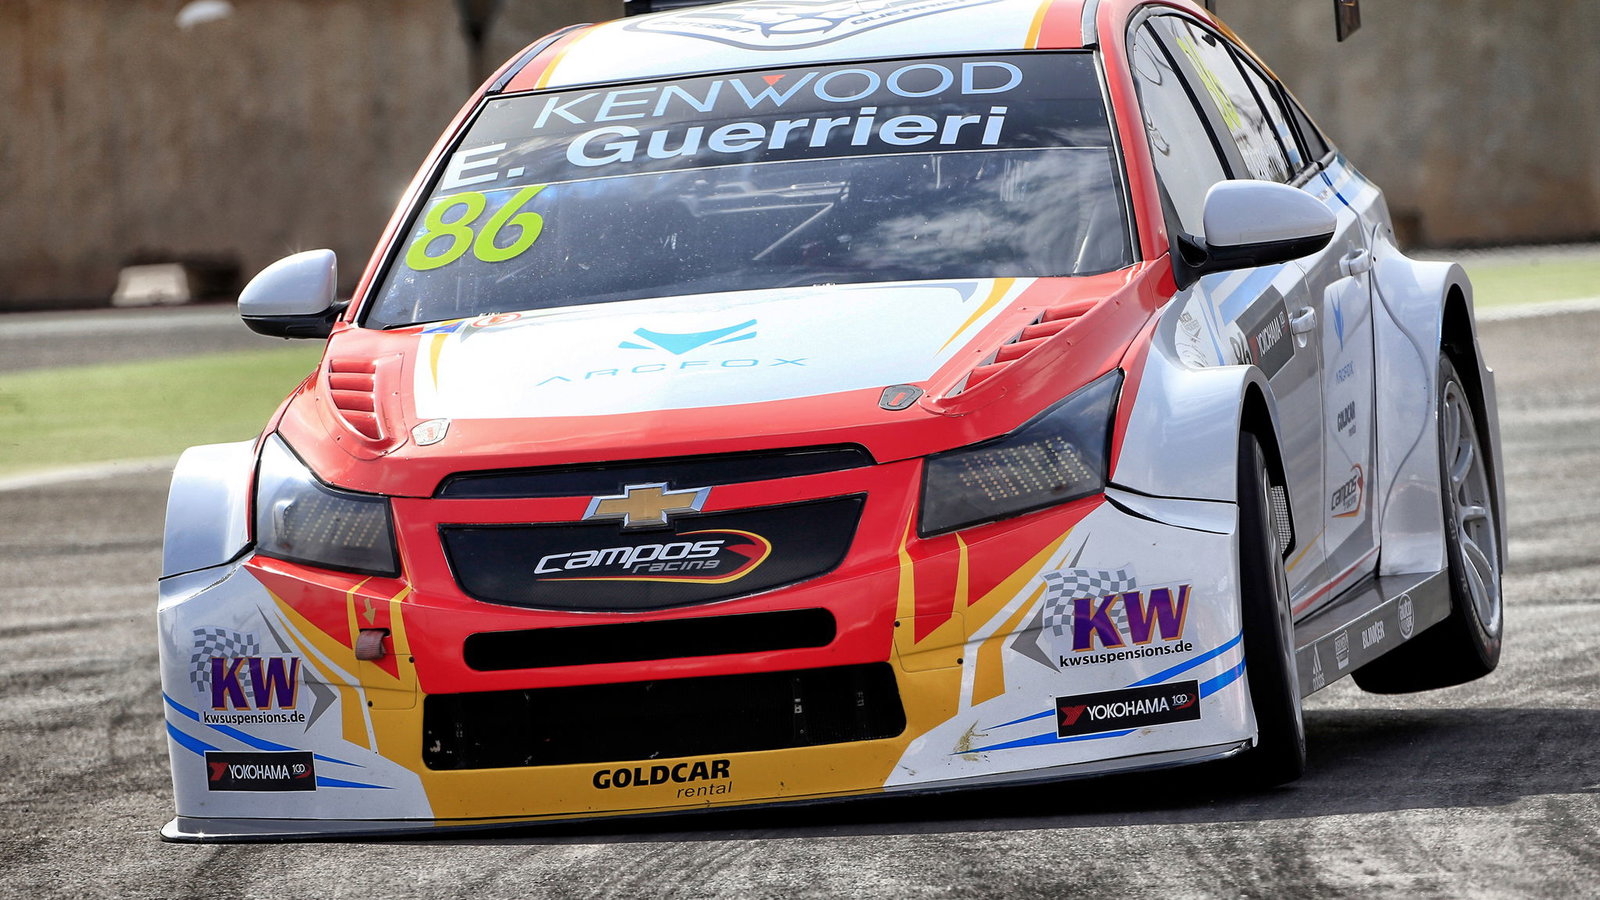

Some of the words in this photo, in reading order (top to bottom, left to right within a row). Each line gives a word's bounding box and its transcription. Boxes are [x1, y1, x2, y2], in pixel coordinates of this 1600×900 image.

[533, 61, 1023, 128] KENWOOD
[441, 142, 525, 190] E.
[566, 106, 1008, 167] Guerrieri
[405, 185, 547, 271] 86
[536, 357, 809, 387] ARCFOX
[533, 539, 726, 575] campos
[631, 559, 721, 574] racing
[1072, 584, 1192, 652] KW
[1059, 640, 1193, 667] kwsuspensions.de
[211, 656, 300, 711] KW
[203, 710, 306, 726] kwsuspensions.de
[1086, 697, 1170, 721] YOKOHAMA
[228, 764, 291, 780] YOKOHAMA
[592, 759, 731, 790] GOLDCAR
[677, 781, 733, 798] rental
